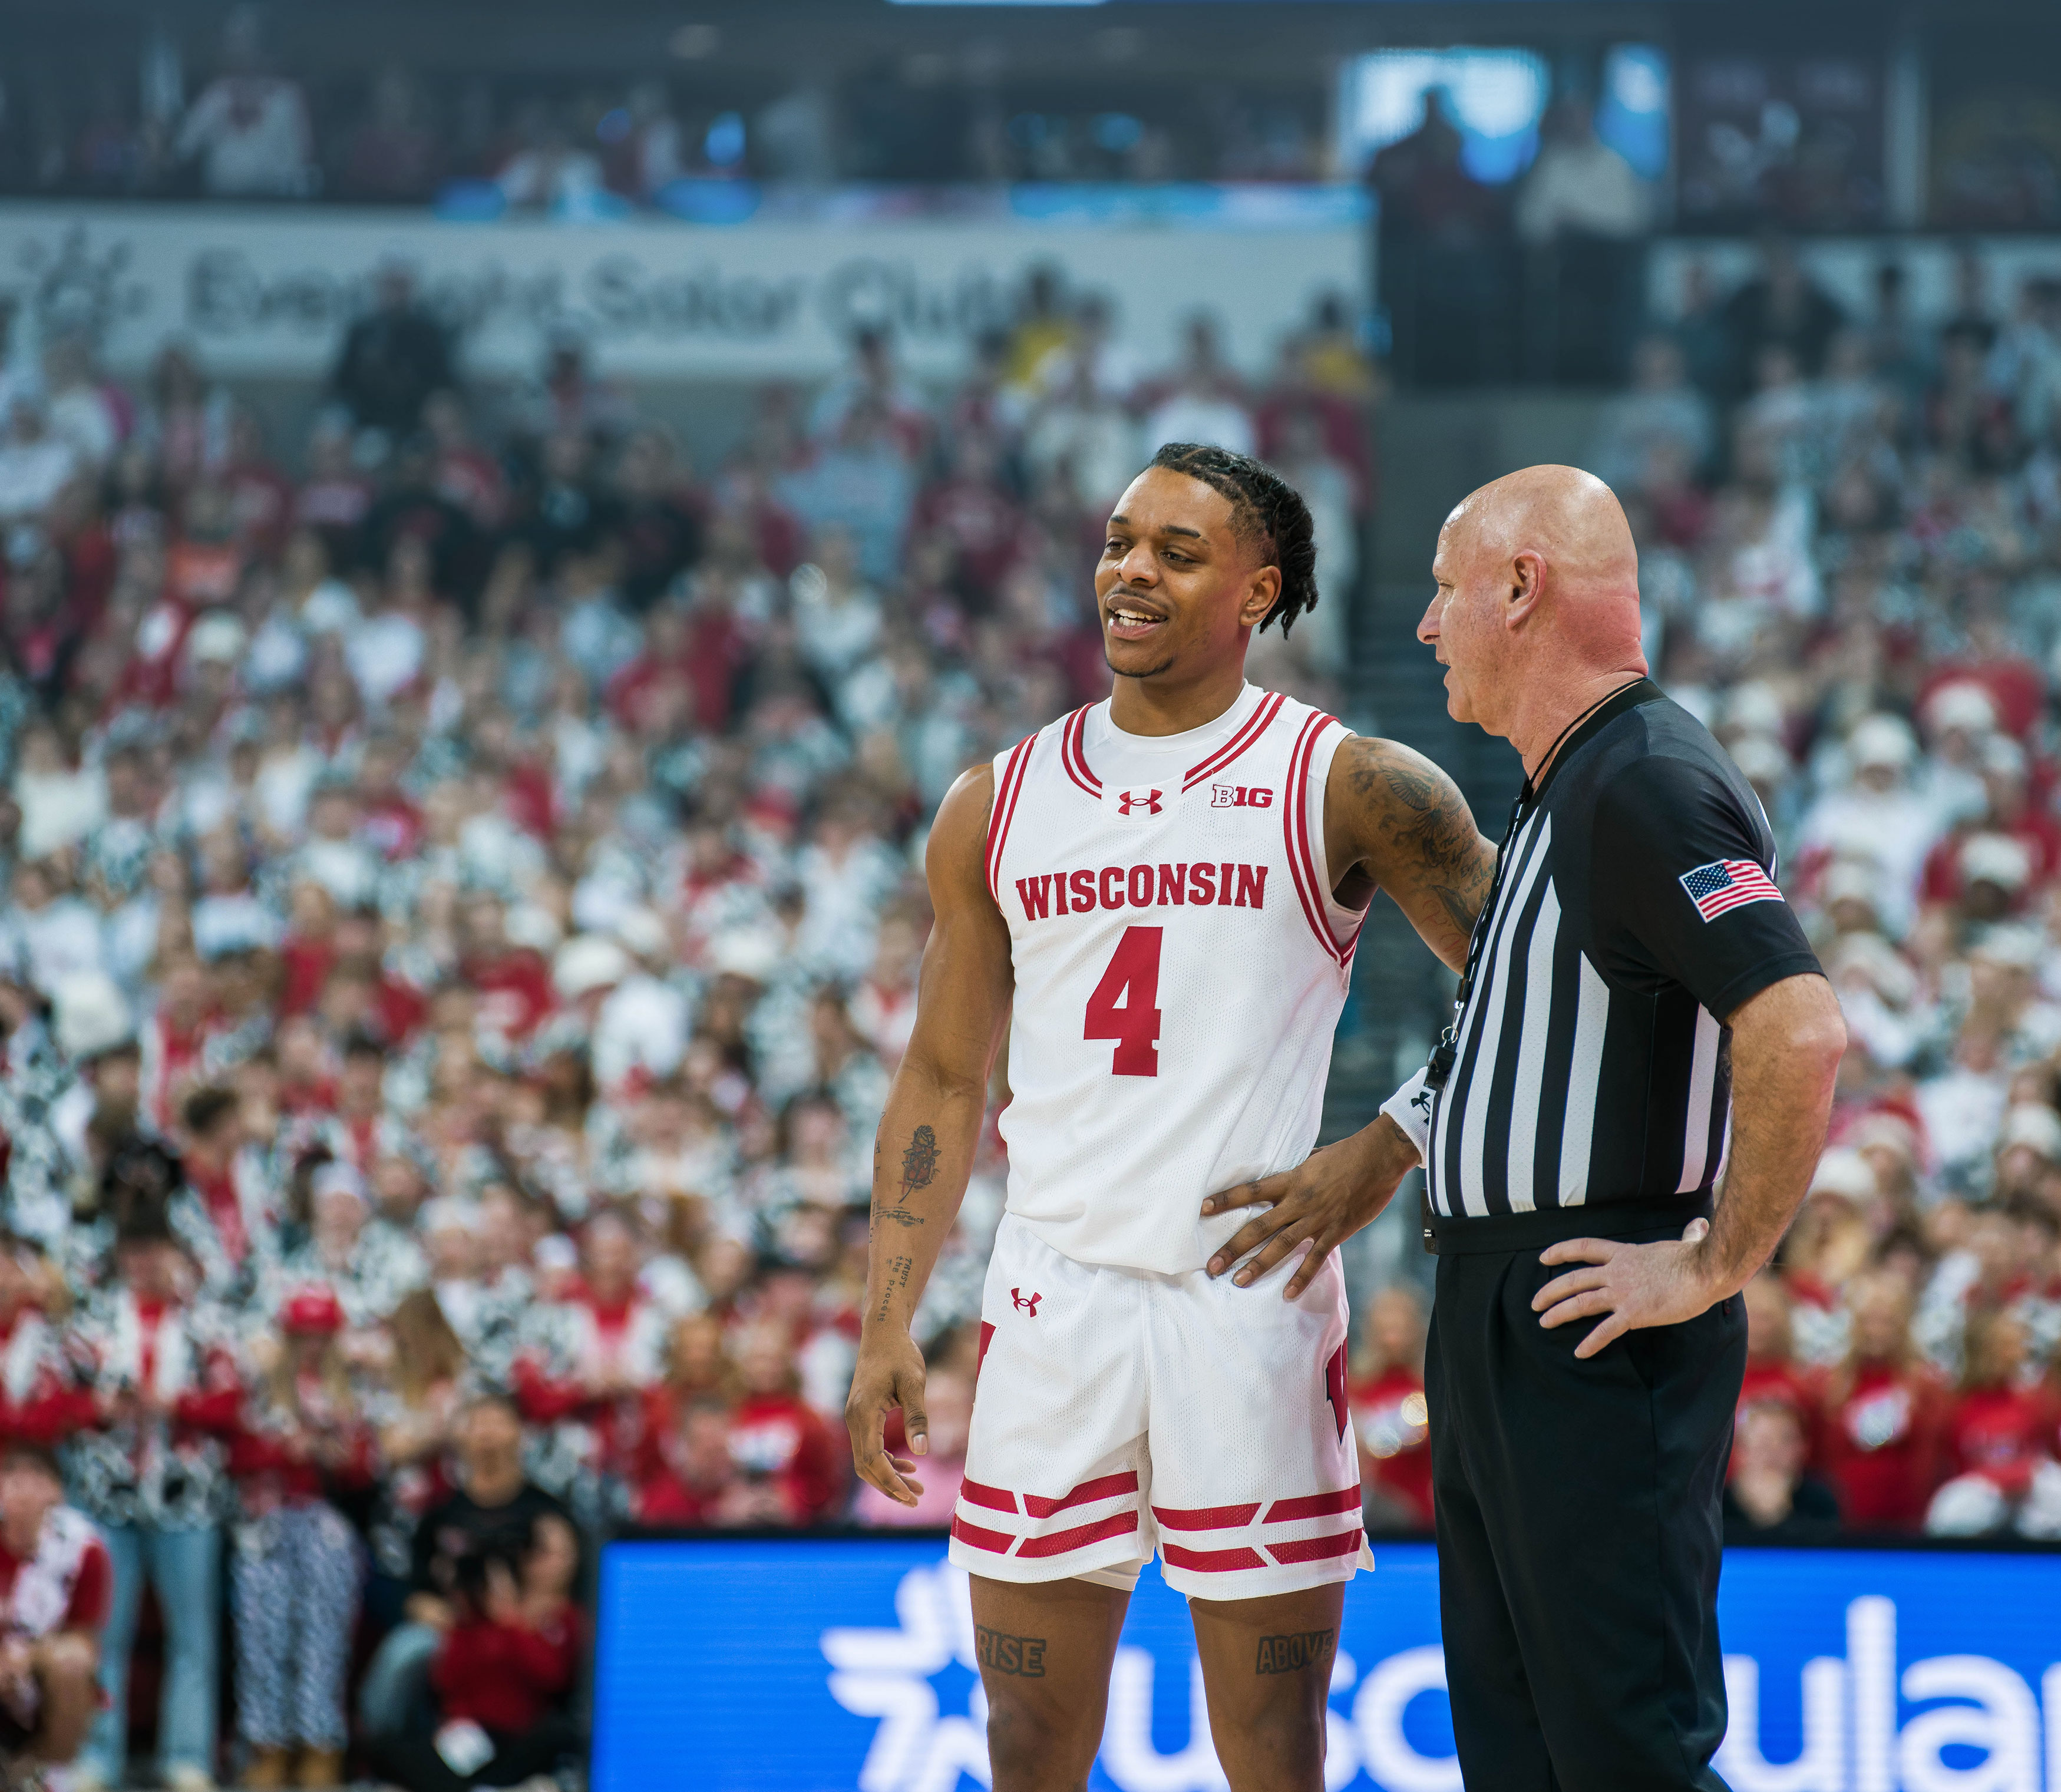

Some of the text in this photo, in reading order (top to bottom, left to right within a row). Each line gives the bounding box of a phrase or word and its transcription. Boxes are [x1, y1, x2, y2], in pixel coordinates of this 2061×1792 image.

[1016, 862, 1268, 921] WISCONSIN
[1084, 926, 1164, 1077] 4
[976, 1624, 1046, 1678] RISE
[1256, 1628, 1335, 1674] ABOVE
